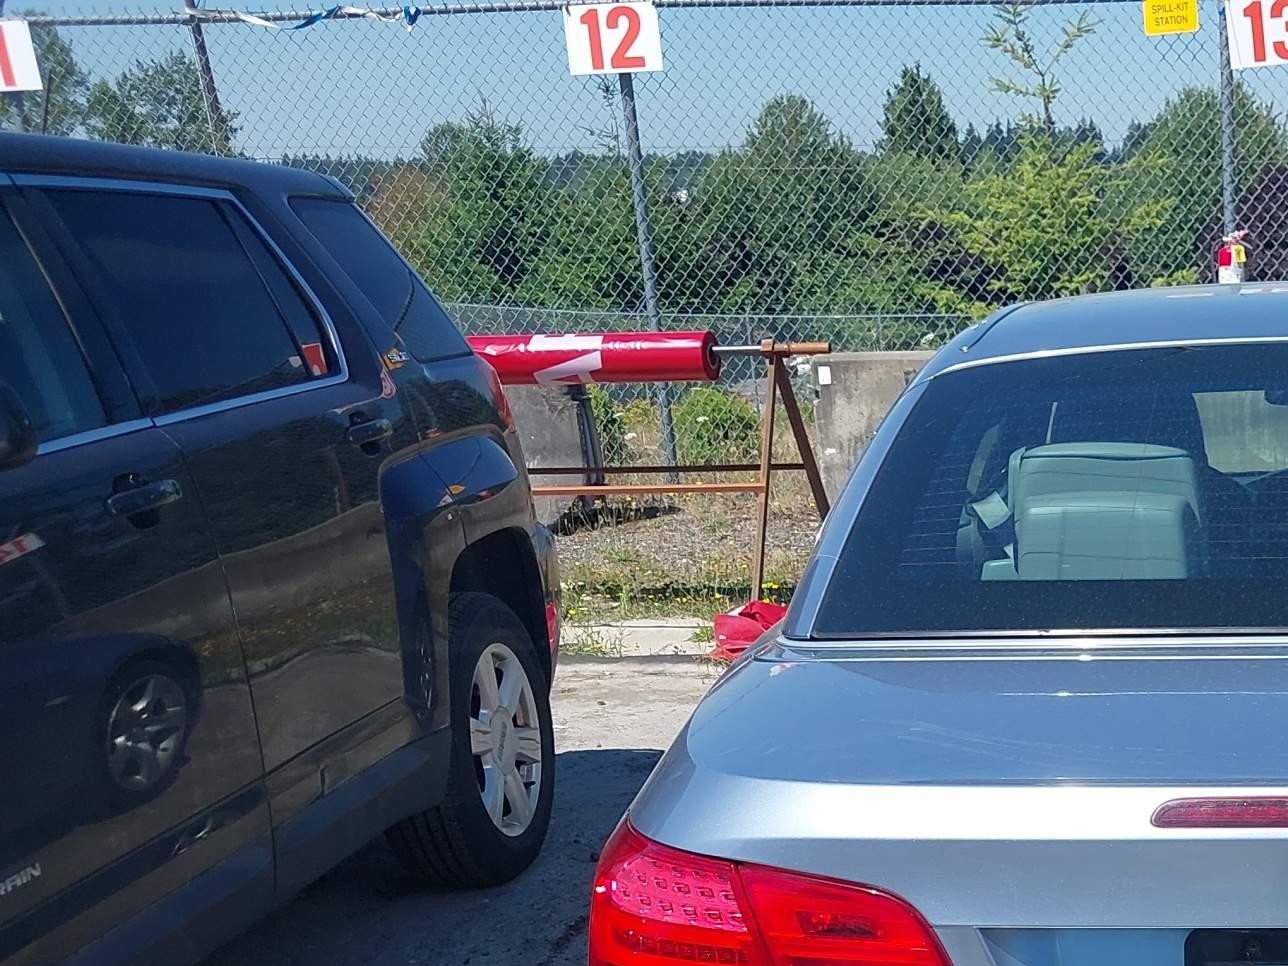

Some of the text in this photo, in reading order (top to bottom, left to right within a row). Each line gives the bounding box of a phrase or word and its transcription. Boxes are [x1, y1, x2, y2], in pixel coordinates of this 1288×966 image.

[1151, 2, 1189, 14] SPILL-KIT
[1154, 15, 1189, 26] STATION
[580, 6, 646, 69] 12
